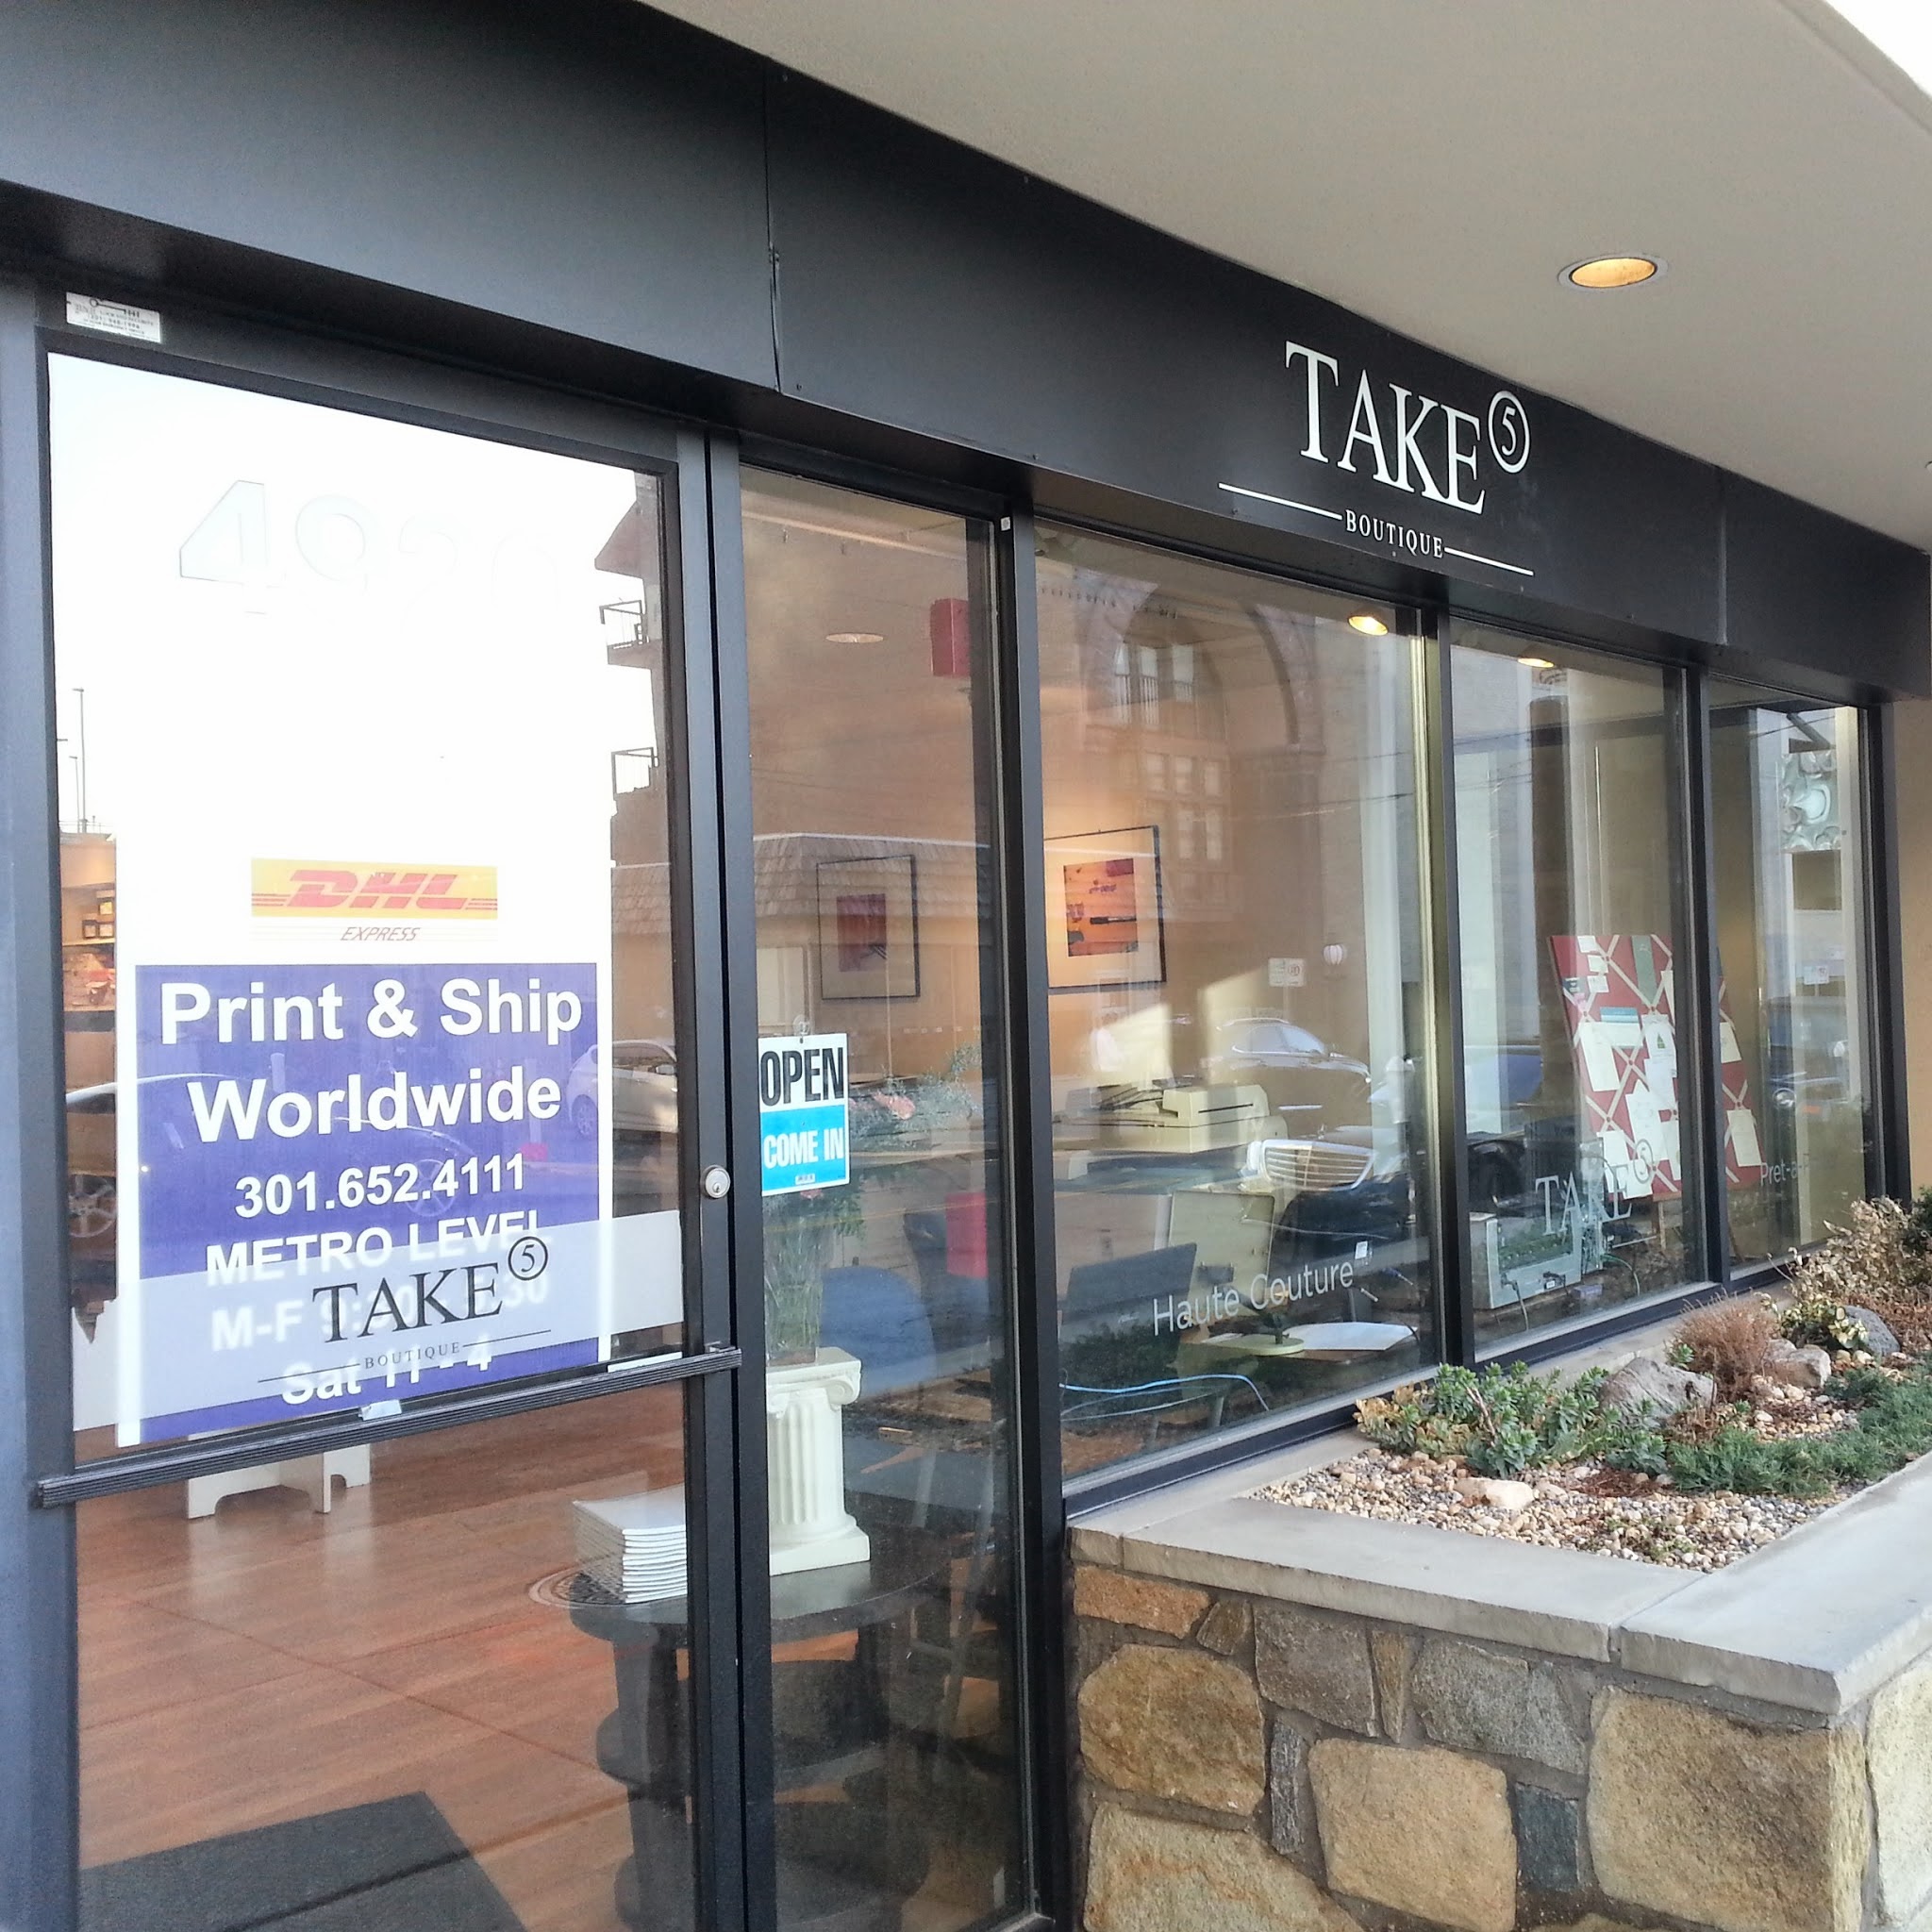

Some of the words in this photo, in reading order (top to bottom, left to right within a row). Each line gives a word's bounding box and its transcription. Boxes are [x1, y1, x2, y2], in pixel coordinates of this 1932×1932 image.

[1285, 340, 1486, 515] TAKE
[1345, 509, 1443, 558] BOUTIQUE
[287, 869, 468, 909] DHL
[340, 926, 421, 941] EXPRESS
[160, 981, 344, 1044] Print
[366, 978, 419, 1038] &
[441, 975, 582, 1044] Ship
[187, 1066, 561, 1143] Worldwide
[760, 1047, 844, 1107] OPEN
[763, 1130, 819, 1169] COME
[824, 1127, 844, 1161] IN
[235, 1153, 525, 1218] 301.652.4111
[206, 1226, 392, 1287] METRO
[408, 1209, 554, 1262] LEVEL
[211, 1299, 304, 1352] M-F
[312, 1262, 503, 1342] TAKE
[1153, 1285, 1240, 1336] Haute
[1250, 1261, 1354, 1310] Couture
[282, 1357, 361, 1405] Sat
[364, 1341, 460, 1370] BOUTIQUE
